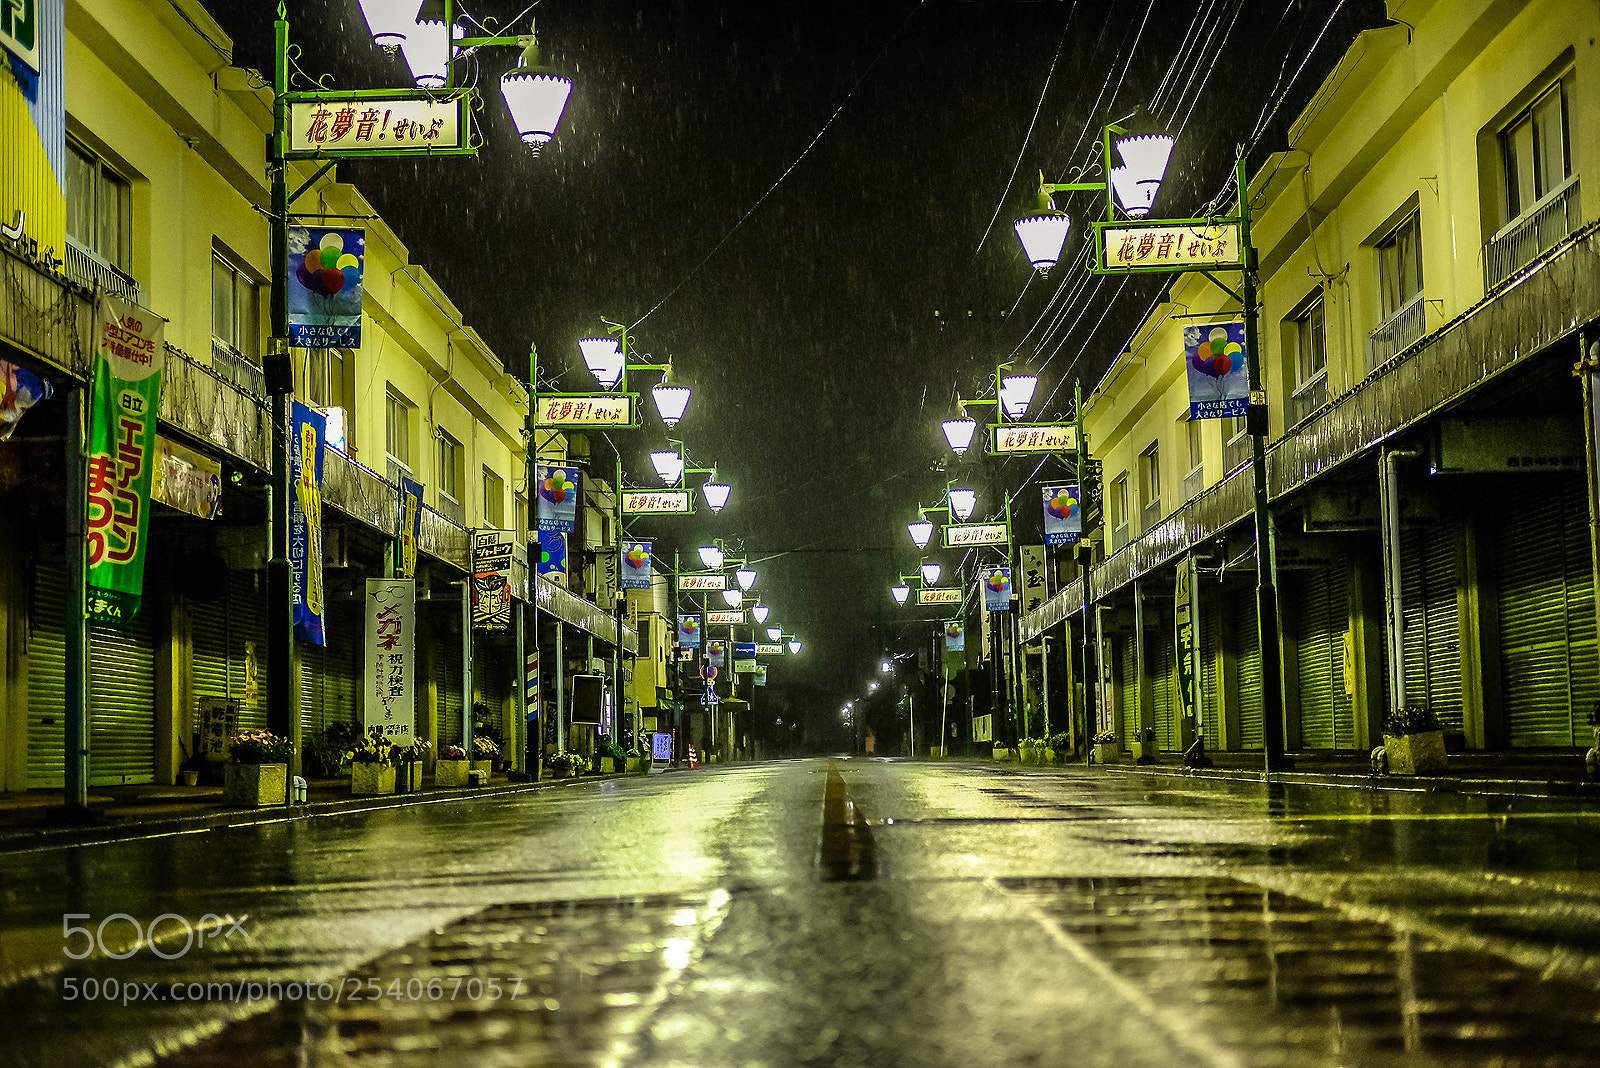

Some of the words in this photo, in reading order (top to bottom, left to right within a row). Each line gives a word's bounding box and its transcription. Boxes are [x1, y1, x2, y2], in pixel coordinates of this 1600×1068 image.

[305, 107, 444, 144] 花夢音!せいぶ
[1117, 232, 1229, 262] 花夢音!せいぶ
[118, 313, 143, 333] 人気の
[122, 393, 143, 413] 日立
[546, 401, 622, 420] 花夢音!せいぶ
[1197, 400, 1243, 411] 小さな店でも
[1005, 431, 1070, 448] 花夢音!せいぶ
[107, 416, 144, 562] エアコン
[376, 603, 403, 651] メガネ
[387, 653, 404, 697] 視力検査
